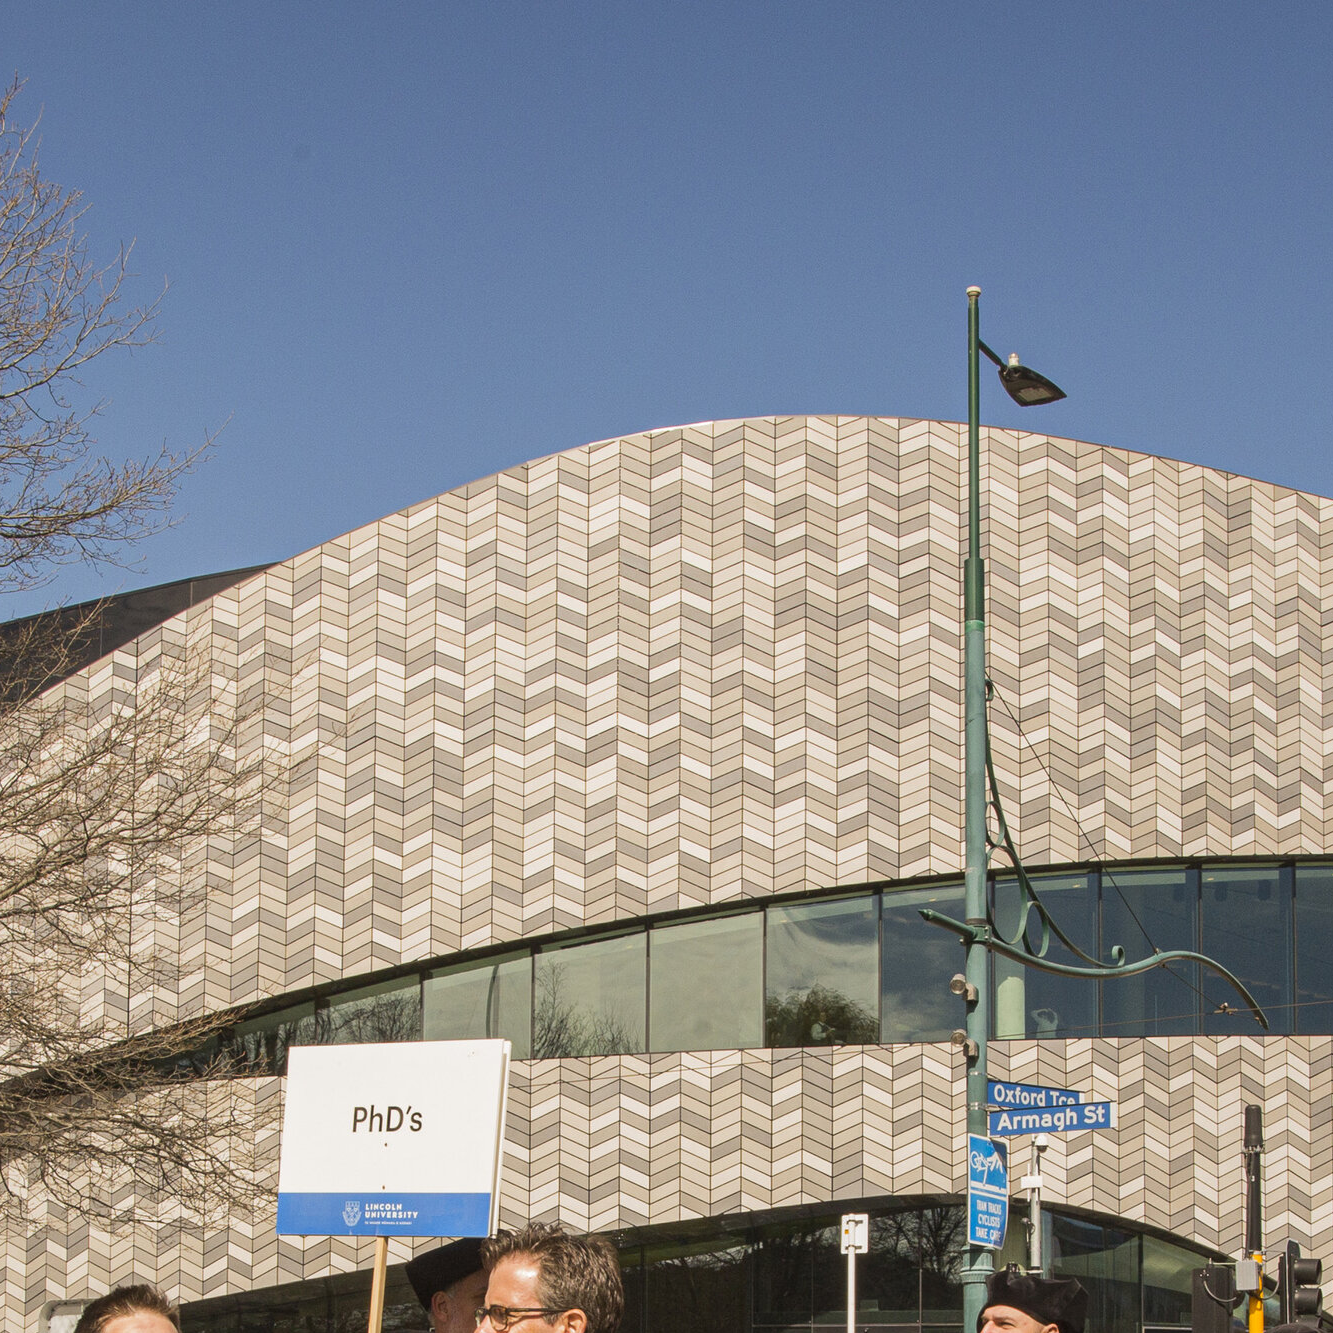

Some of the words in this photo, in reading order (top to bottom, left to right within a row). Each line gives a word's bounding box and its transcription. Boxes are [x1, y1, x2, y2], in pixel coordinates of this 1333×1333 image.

[994, 1084, 1046, 1107] Oxford
[1050, 1091, 1076, 1105] Tce
[352, 1105, 423, 1133] PhD's
[997, 1108, 1078, 1131] Armagh
[1084, 1105, 1106, 1124] St
[365, 1203, 403, 1211] LINCOLN
[977, 1200, 987, 1211] TRAM
[988, 1201, 1002, 1215] TRACKS
[364, 1211, 419, 1219] UNIVERSITY
[978, 1214, 1000, 1228] CYCLISTS
[975, 1226, 988, 1239] TAKE
